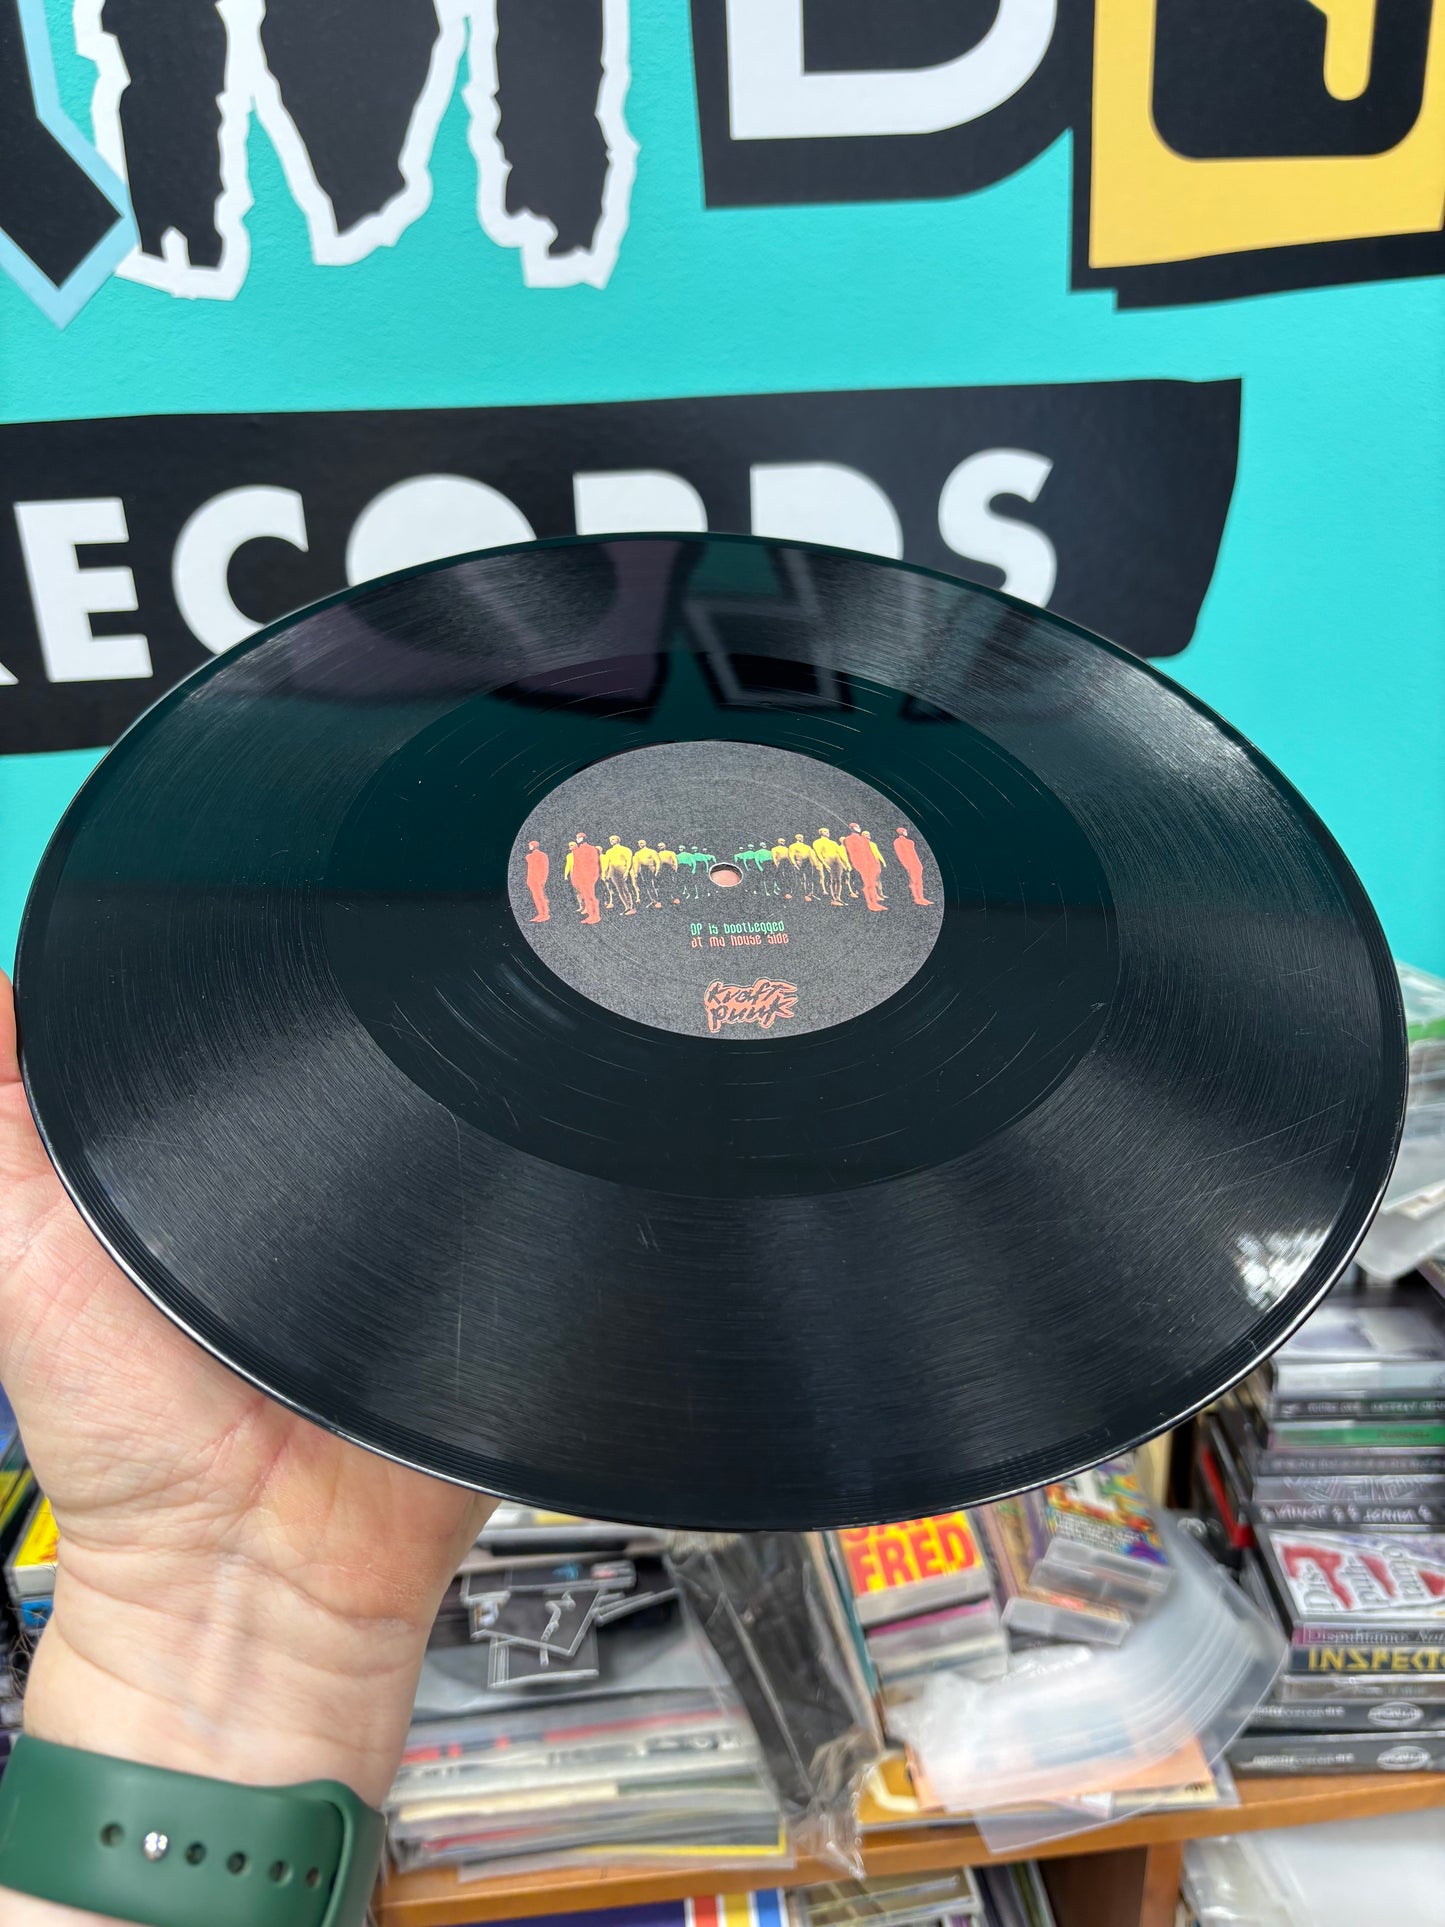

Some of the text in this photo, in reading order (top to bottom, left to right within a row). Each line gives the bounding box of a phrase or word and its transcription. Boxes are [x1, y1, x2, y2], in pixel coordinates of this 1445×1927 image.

[708, 922, 718, 935] is
[691, 936, 703, 948] at
[730, 934, 762, 946] house
[767, 932, 789, 944] side
[848, 1523, 975, 1594] FRED
[1307, 1646, 1445, 1671] INSPECT
